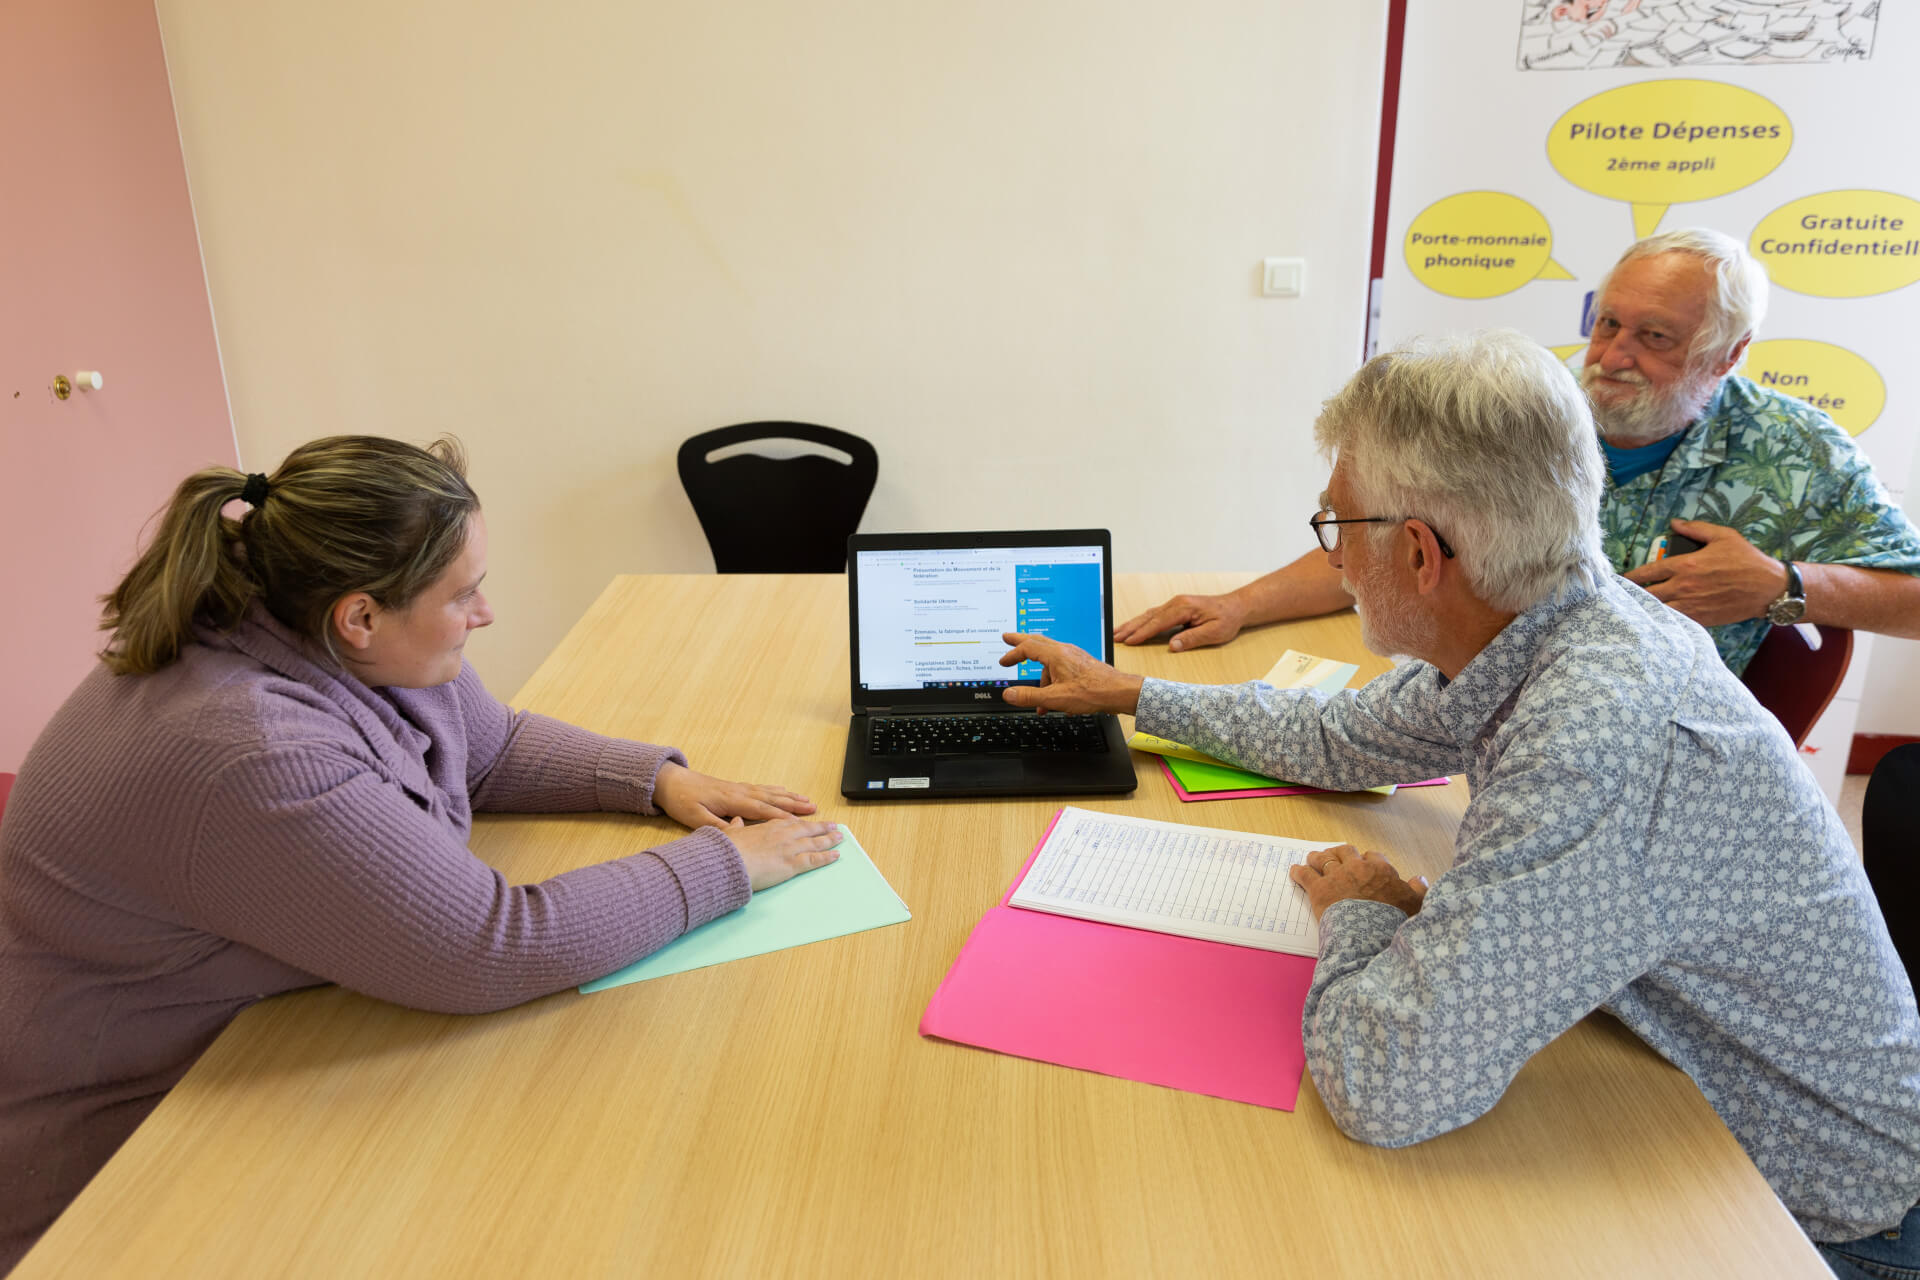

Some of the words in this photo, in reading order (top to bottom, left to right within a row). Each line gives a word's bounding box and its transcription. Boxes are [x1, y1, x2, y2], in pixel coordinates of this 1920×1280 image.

[1570, 122, 1644, 140] Pilote
[1652, 121, 1781, 143] Dépenses
[1606, 157, 1661, 171] 2ème
[1666, 157, 1716, 173] appli
[1800, 214, 1904, 231] Gratuite
[1411, 232, 1547, 247] Porte-monnaie
[1424, 253, 1515, 270] phonique
[1761, 371, 1809, 386] Non
[975, 692, 992, 700] DELL
